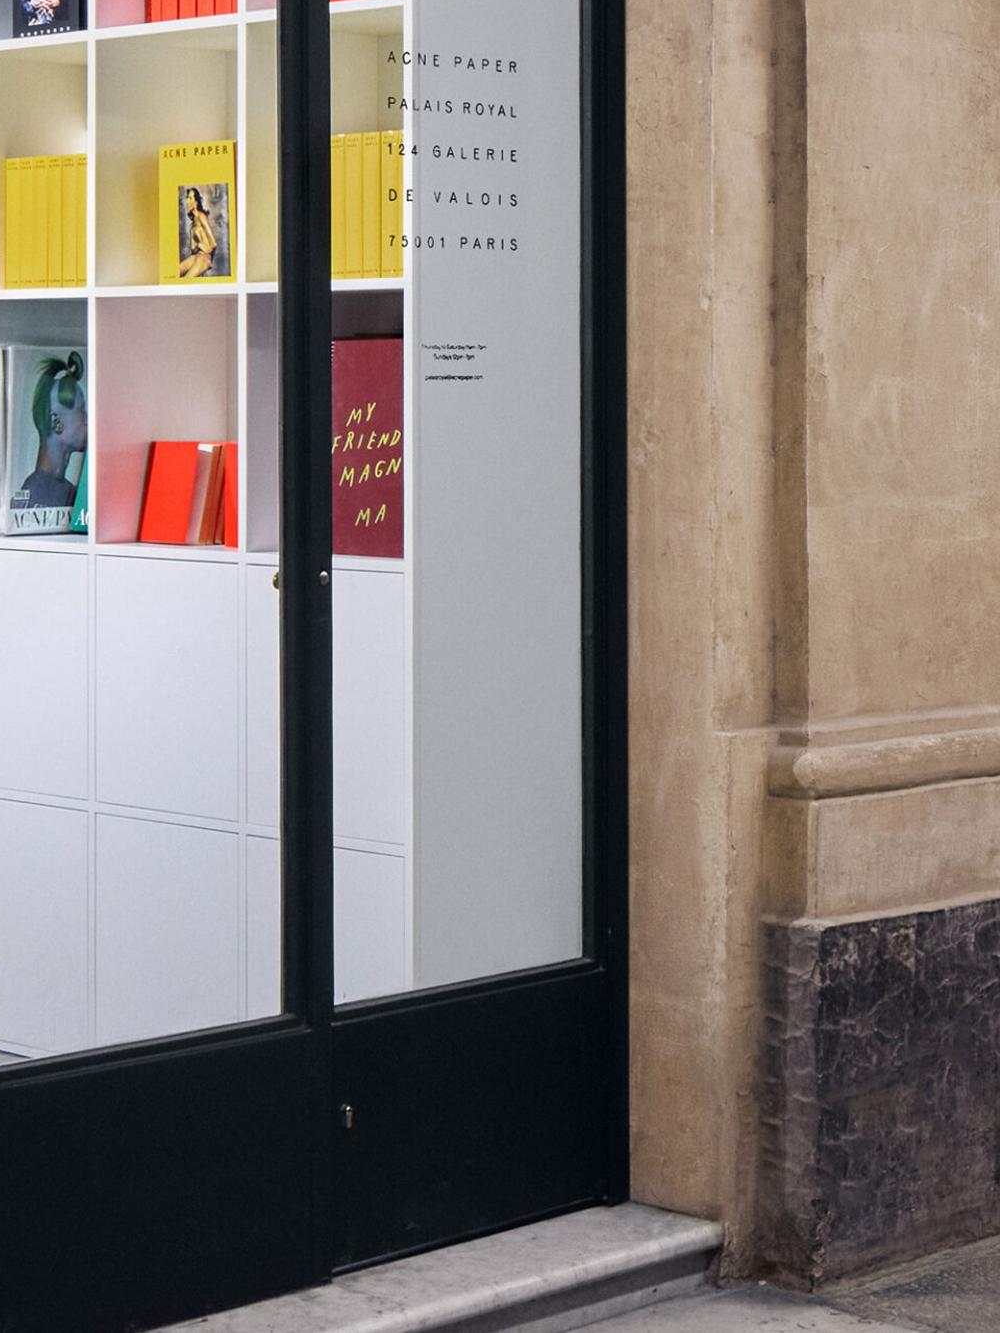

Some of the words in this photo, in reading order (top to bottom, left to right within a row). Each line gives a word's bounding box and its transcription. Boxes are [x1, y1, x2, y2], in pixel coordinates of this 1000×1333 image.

[387, 51, 440, 67] ACNE
[454, 56, 517, 73] PAPER
[387, 96, 453, 114] PALAIS
[463, 102, 517, 118] ROYAL
[194, 145, 228, 156] PAPER
[388, 143, 418, 156] 124
[432, 145, 517, 162] GALERIE
[388, 188, 414, 202] DE
[433, 191, 518, 207] VALOIS
[389, 235, 446, 249] 75001
[460, 237, 518, 251] PARIS
[346, 402, 376, 427] MY
[331, 429, 402, 454] FRIEND
[338, 458, 402, 488] MAGN
[355, 504, 387, 527] MA
